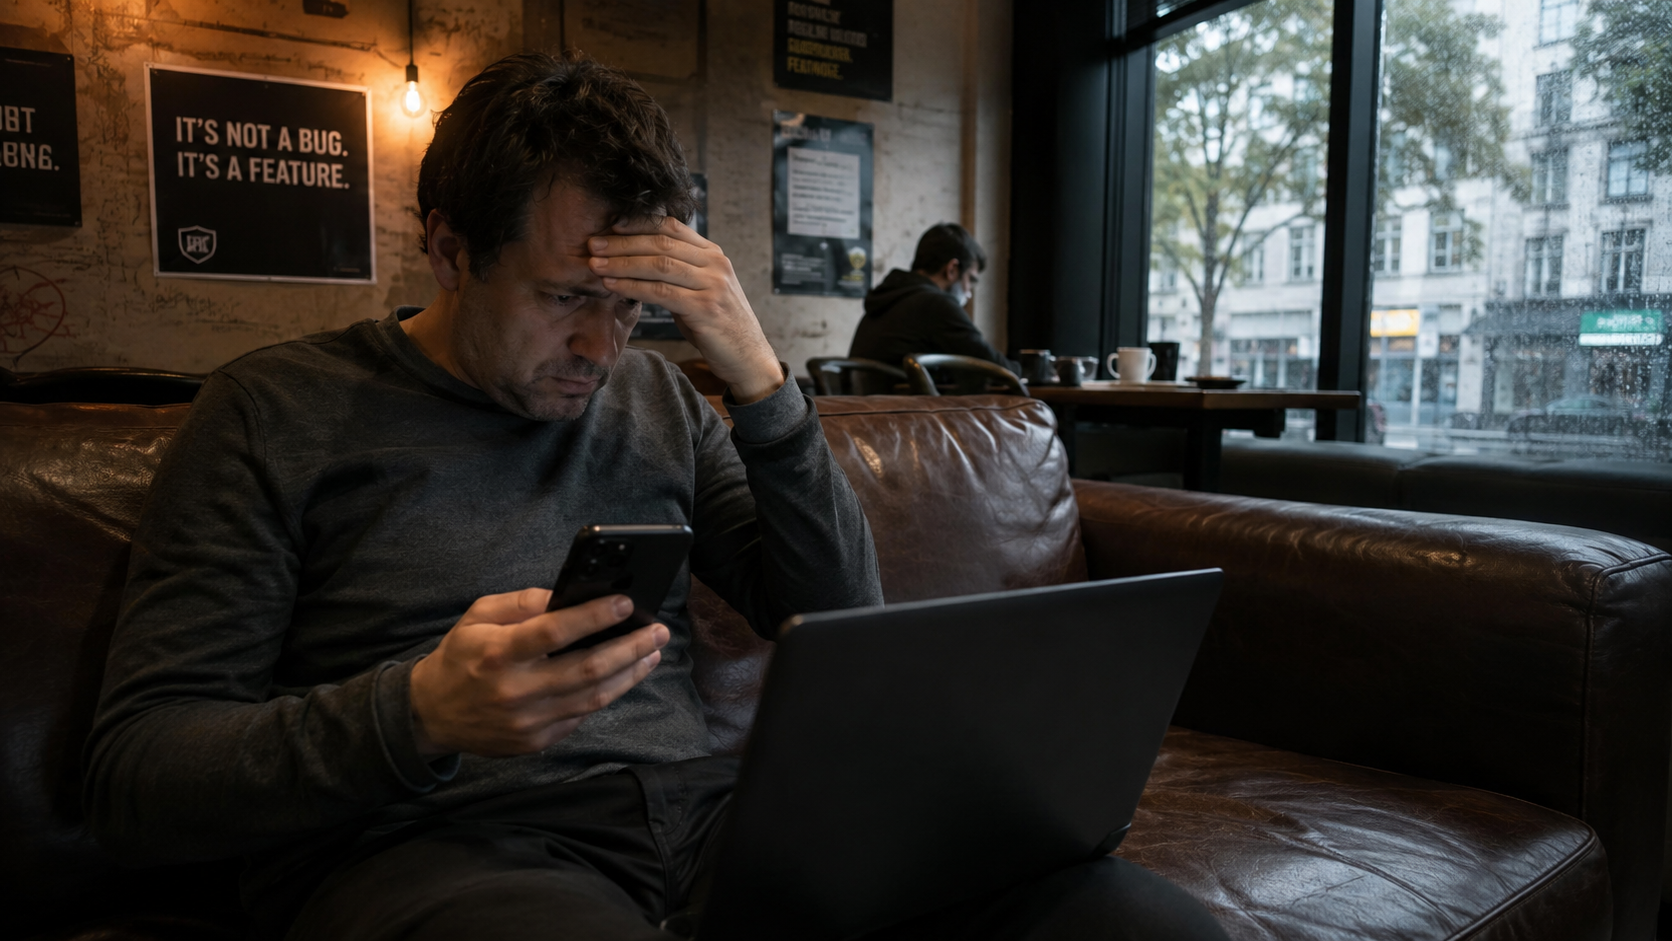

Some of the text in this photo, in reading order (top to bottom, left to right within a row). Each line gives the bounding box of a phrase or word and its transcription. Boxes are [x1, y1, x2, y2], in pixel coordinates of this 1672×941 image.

[176, 116, 349, 158] IT'S NOT A BUG.
[177, 151, 350, 190] IT'S A FEATURE.
